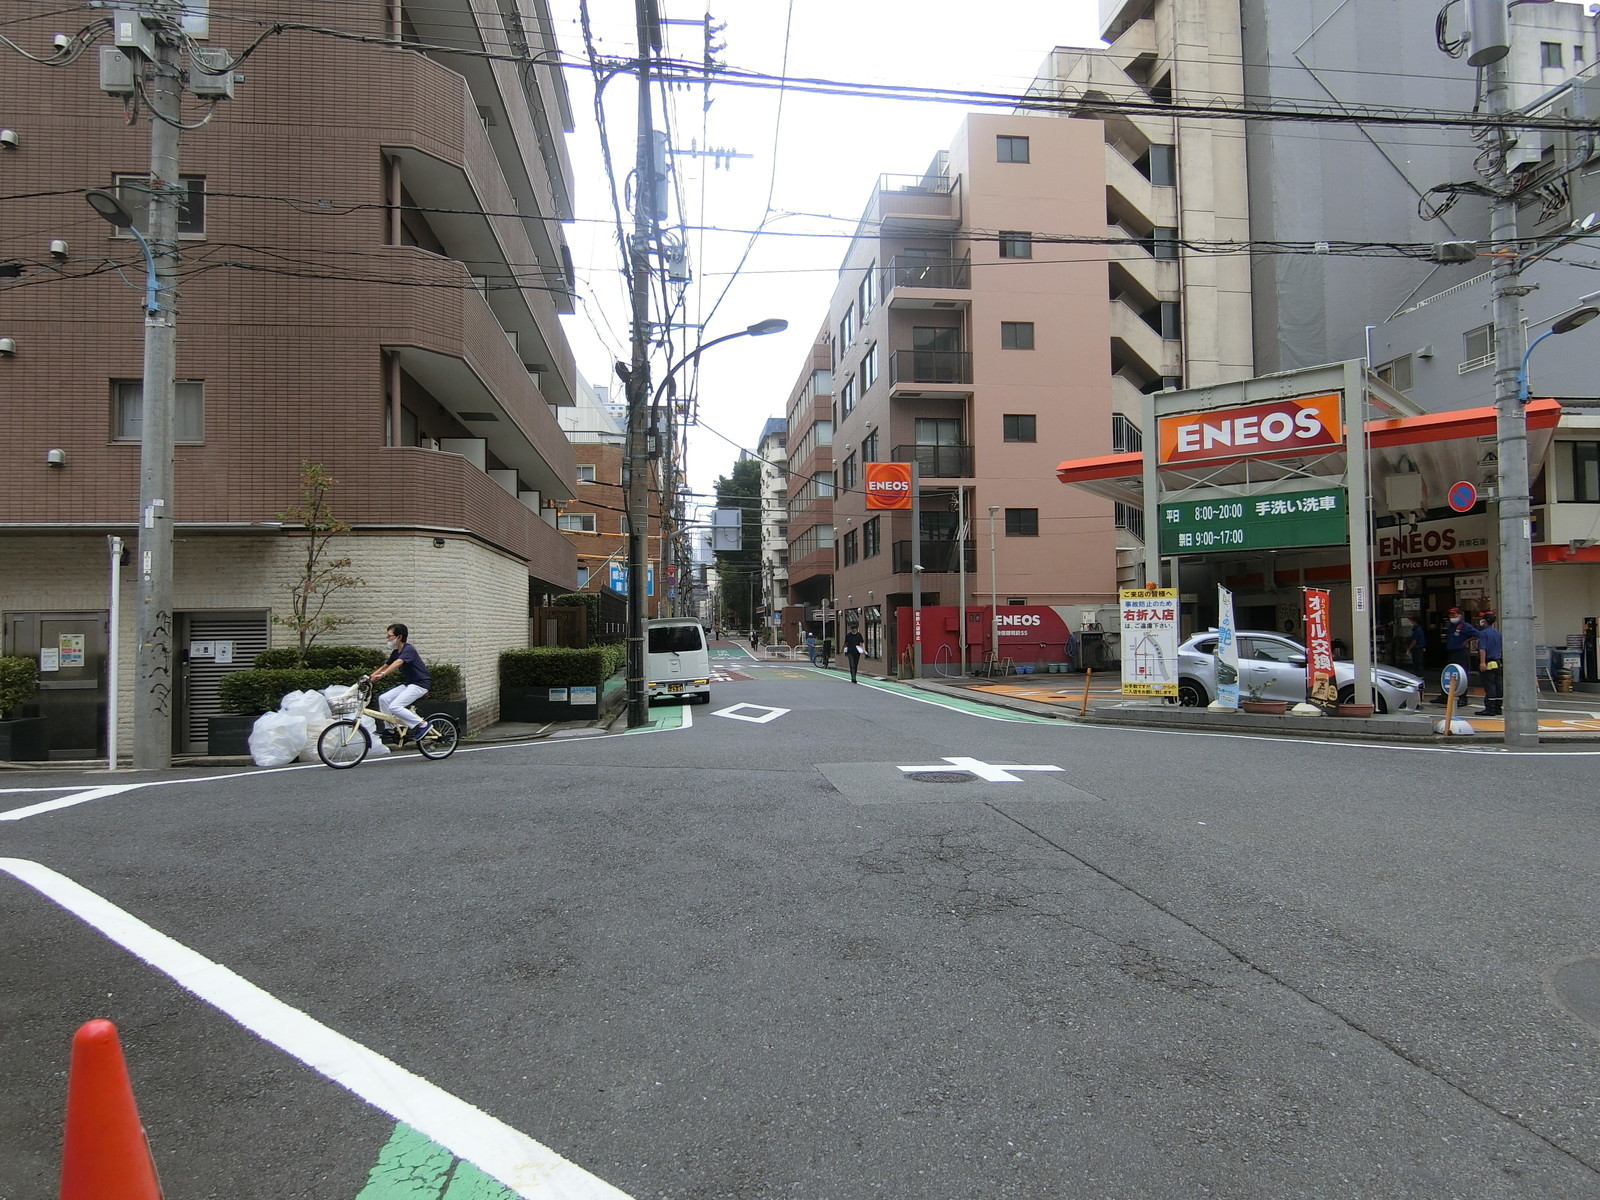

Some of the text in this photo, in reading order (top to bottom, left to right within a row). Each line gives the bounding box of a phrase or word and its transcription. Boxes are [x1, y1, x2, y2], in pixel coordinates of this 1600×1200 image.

[1177, 407, 1321, 452] ENEOS
[868, 481, 909, 491] ENEOS
[1255, 496, 1336, 516] 手洗い洗車
[1166, 509, 1180, 523] 平日
[1178, 533, 1193, 547] 祭日
[1379, 528, 1457, 557] ENEOS
[1392, 558, 1448, 570] Service Room
[1123, 590, 1173, 598] ご来店の皆様へ
[1124, 600, 1173, 608] 事故防止のため
[996, 614, 1041, 626] ENEOS
[1123, 608, 1175, 621] 右折入店
[1308, 595, 1332, 671] オイル交換
